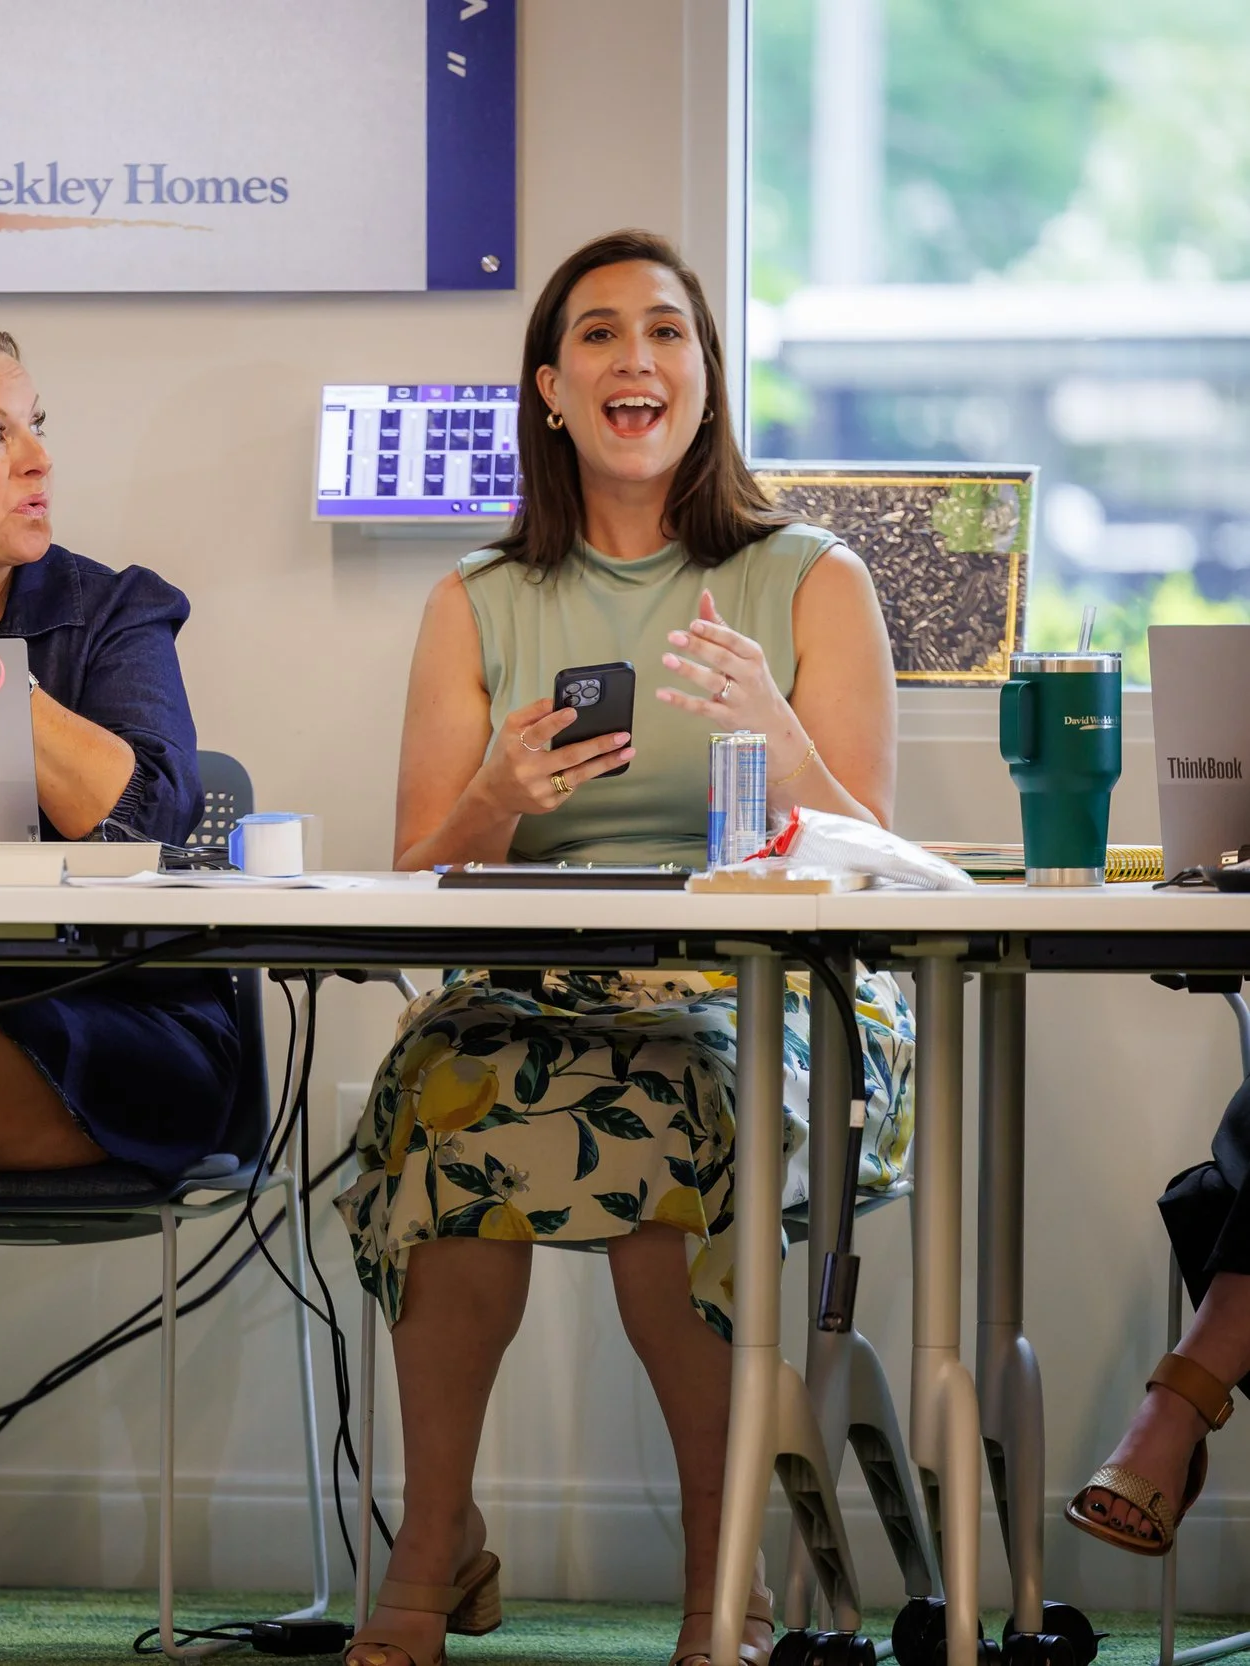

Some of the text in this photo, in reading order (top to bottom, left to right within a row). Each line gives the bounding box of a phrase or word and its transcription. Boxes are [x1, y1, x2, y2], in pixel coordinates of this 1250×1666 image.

[124, 164, 288, 205] Homes
[1064, 716, 1089, 725] David
[1167, 757, 1243, 779] ThinkBook
